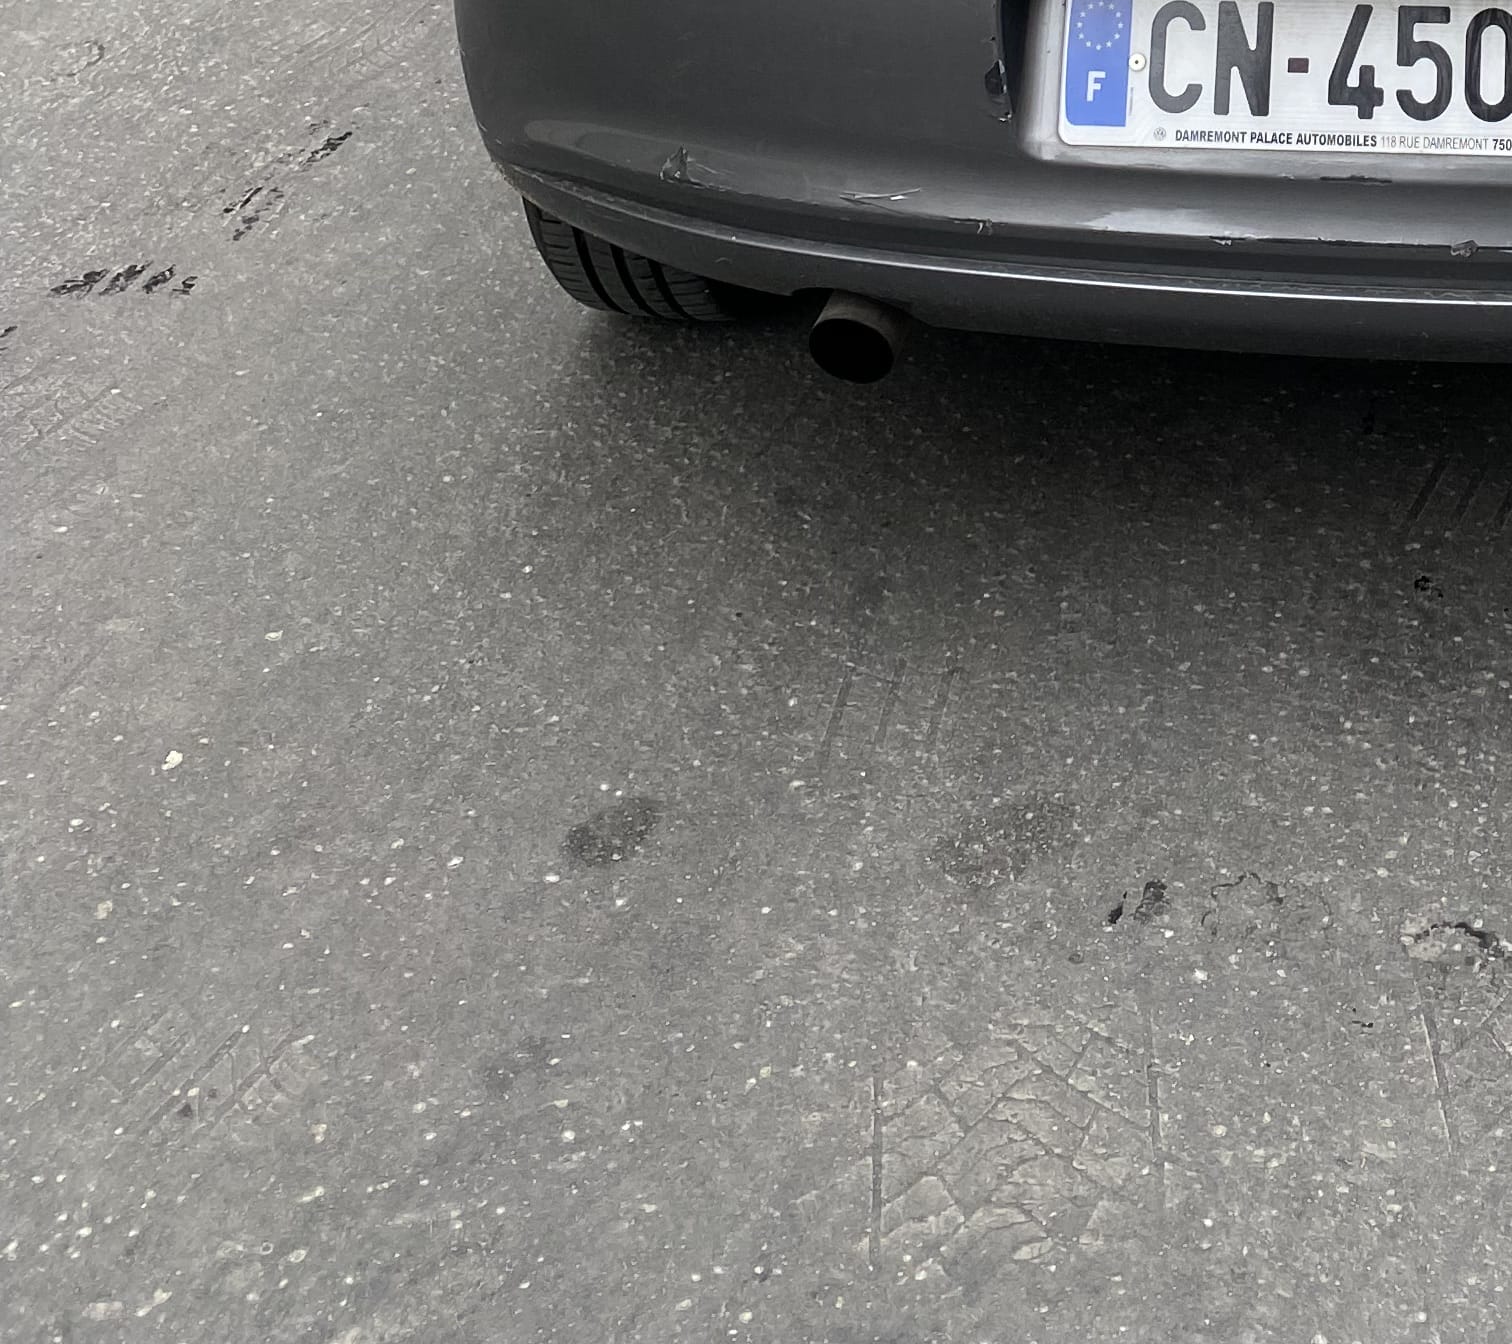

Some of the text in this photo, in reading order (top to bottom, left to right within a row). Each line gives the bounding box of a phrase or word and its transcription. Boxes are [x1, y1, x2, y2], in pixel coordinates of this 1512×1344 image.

[1086, 70, 1106, 102] F
[1175, 128, 1247, 144] DAMREMONT
[1250, 131, 1293, 145] PALACE
[1296, 132, 1377, 147] AUTOMOBILES
[1380, 136, 1397, 148] 118
[1399, 136, 1420, 149] RUE
[1423, 136, 1489, 151] DAMREMONT
